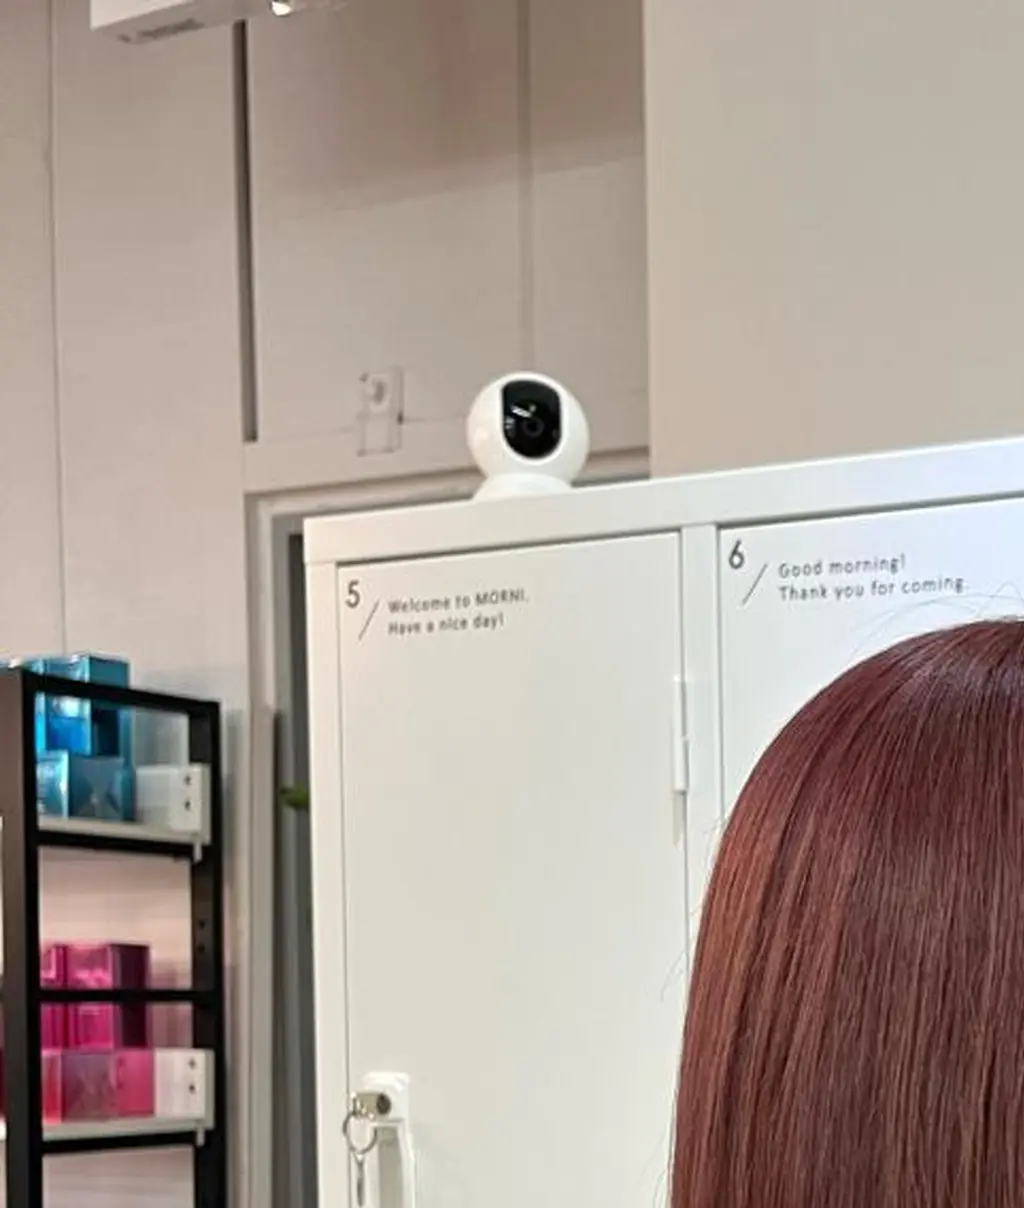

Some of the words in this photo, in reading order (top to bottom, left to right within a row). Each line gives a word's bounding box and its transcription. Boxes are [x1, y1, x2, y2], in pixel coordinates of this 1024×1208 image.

[728, 539, 745, 569] 6
[778, 560, 822, 579] Good
[829, 552, 906, 575] morning!
[345, 579, 361, 609] 5
[779, 584, 827, 602] Thank
[834, 584, 865, 601] you
[871, 579, 895, 597] for
[388, 596, 451, 614] Welcome
[455, 594, 471, 609] to
[388, 621, 421, 636] Have
[427, 621, 435, 634] a
[439, 617, 468, 632] nice
[473, 611, 505, 630] day!
